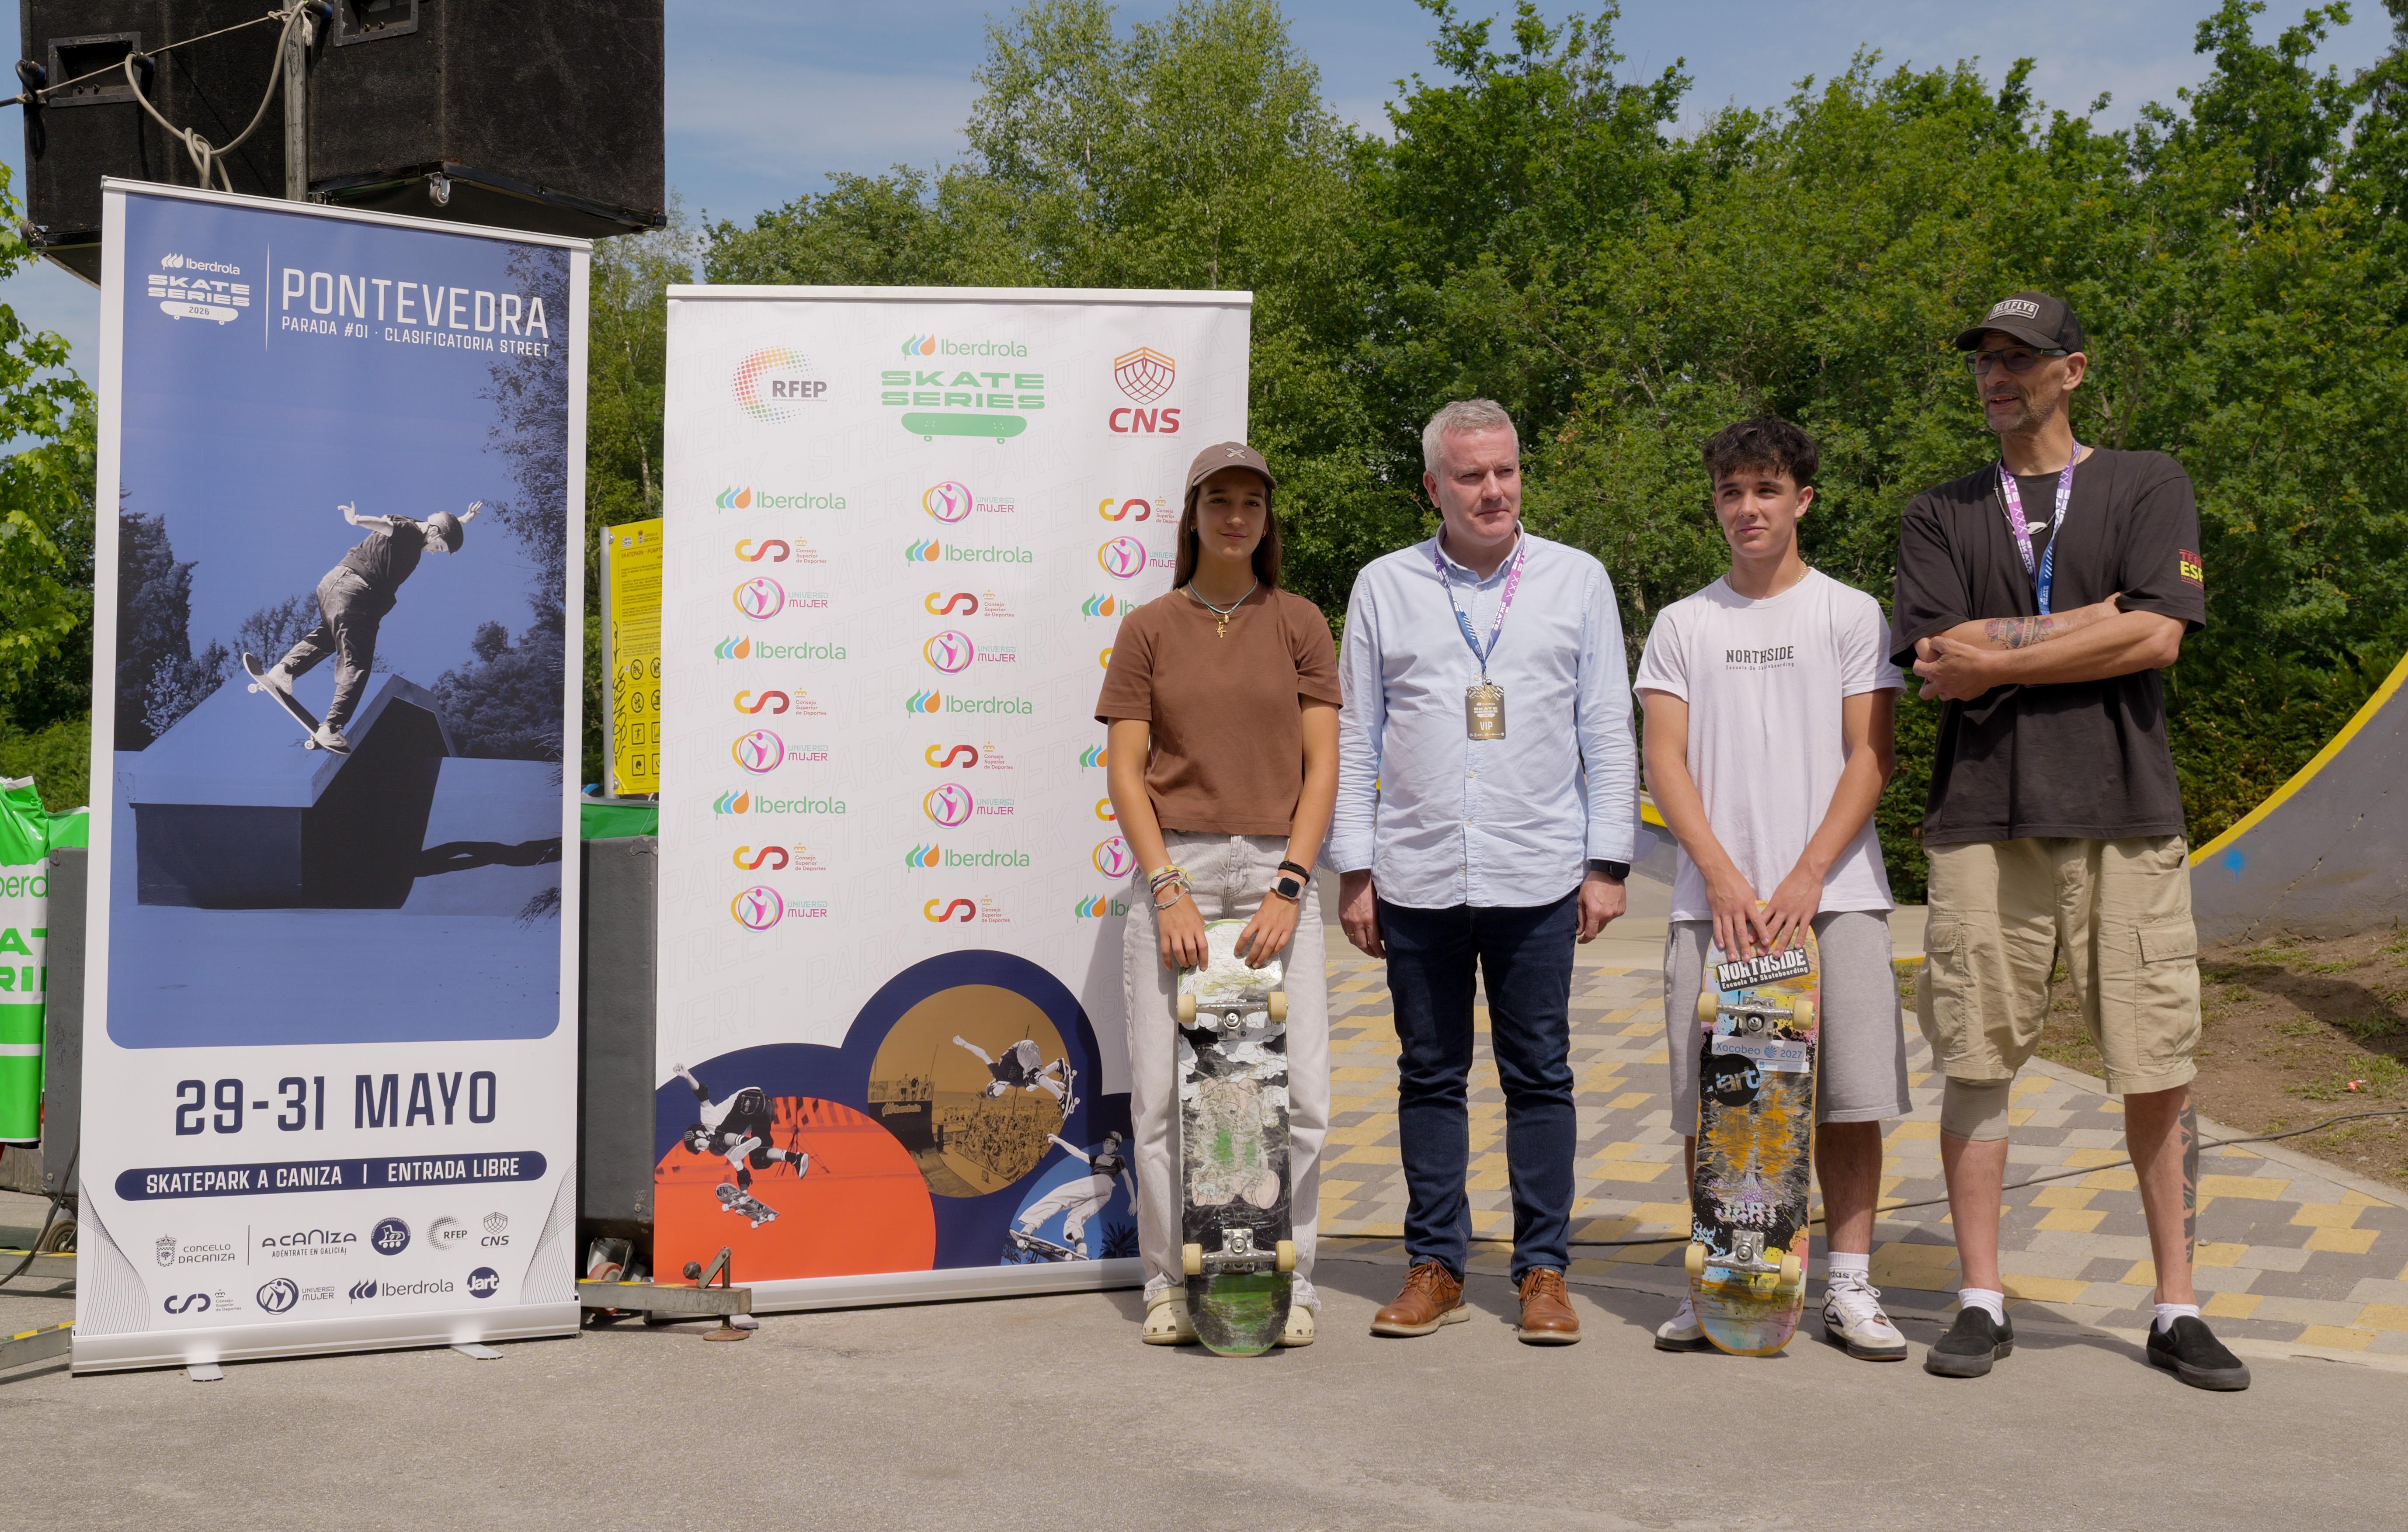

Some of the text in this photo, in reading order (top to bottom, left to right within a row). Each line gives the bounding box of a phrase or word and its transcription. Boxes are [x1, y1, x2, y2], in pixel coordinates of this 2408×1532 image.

[186, 258, 240, 275] Iberdrola
[148, 274, 250, 295] SKATE
[148, 287, 250, 307] SERIES
[282, 268, 549, 338] PONTEVEDRA
[188, 306, 210, 315] 2026
[282, 316, 549, 357] PARADA #01 CLASIFICATORIA STREET
[941, 339, 1027, 357] Iberdrola
[881, 371, 1044, 390] SKATE
[772, 381, 827, 398] RFEP
[881, 391, 1045, 409] SERIES
[1109, 408, 1181, 433] CNS
[757, 492, 846, 509] Iberdrola
[976, 504, 1015, 513] MUJER
[946, 544, 1032, 563] Iberdrola
[1149, 559, 1176, 568] MUJE
[788, 600, 828, 608] MUJER
[756, 641, 846, 659] Iberdrola
[978, 653, 1016, 662] MUJER
[1726, 646, 1794, 664] NORTHSIDE
[946, 695, 1032, 714] Iberdrola
[1480, 721, 1493, 731] VIP
[788, 752, 828, 761] MUJER
[755, 795, 846, 814] Iberdrola
[977, 806, 1014, 815] MUJER
[945, 849, 1030, 867] Iberdrola
[788, 909, 827, 917] MUJER
[1717, 949, 1806, 982] NORTHSIDE
[1721, 980, 1748, 989] Escuela
[1760, 967, 1808, 981] Skateboarding
[1716, 1042, 1803, 1059] Xacobeo 2027
[175, 1071, 497, 1136] 29-31 MAYO
[146, 1157, 520, 1194] SKATEPARK A CANIZA ENTRADA LIBRE
[262, 1237, 276, 1248] A
[280, 1229, 357, 1246] CANIZA
[444, 1230, 467, 1239] RFEP
[481, 1235, 509, 1247] CNS
[183, 1244, 231, 1253] CONCELLO
[272, 1249, 307, 1258] ADÉNTRATE
[320, 1247, 347, 1256] GALICIA!
[382, 1279, 454, 1296] Iberdrola
[466, 1274, 500, 1291] Jart
[302, 1292, 334, 1301] MUJER
